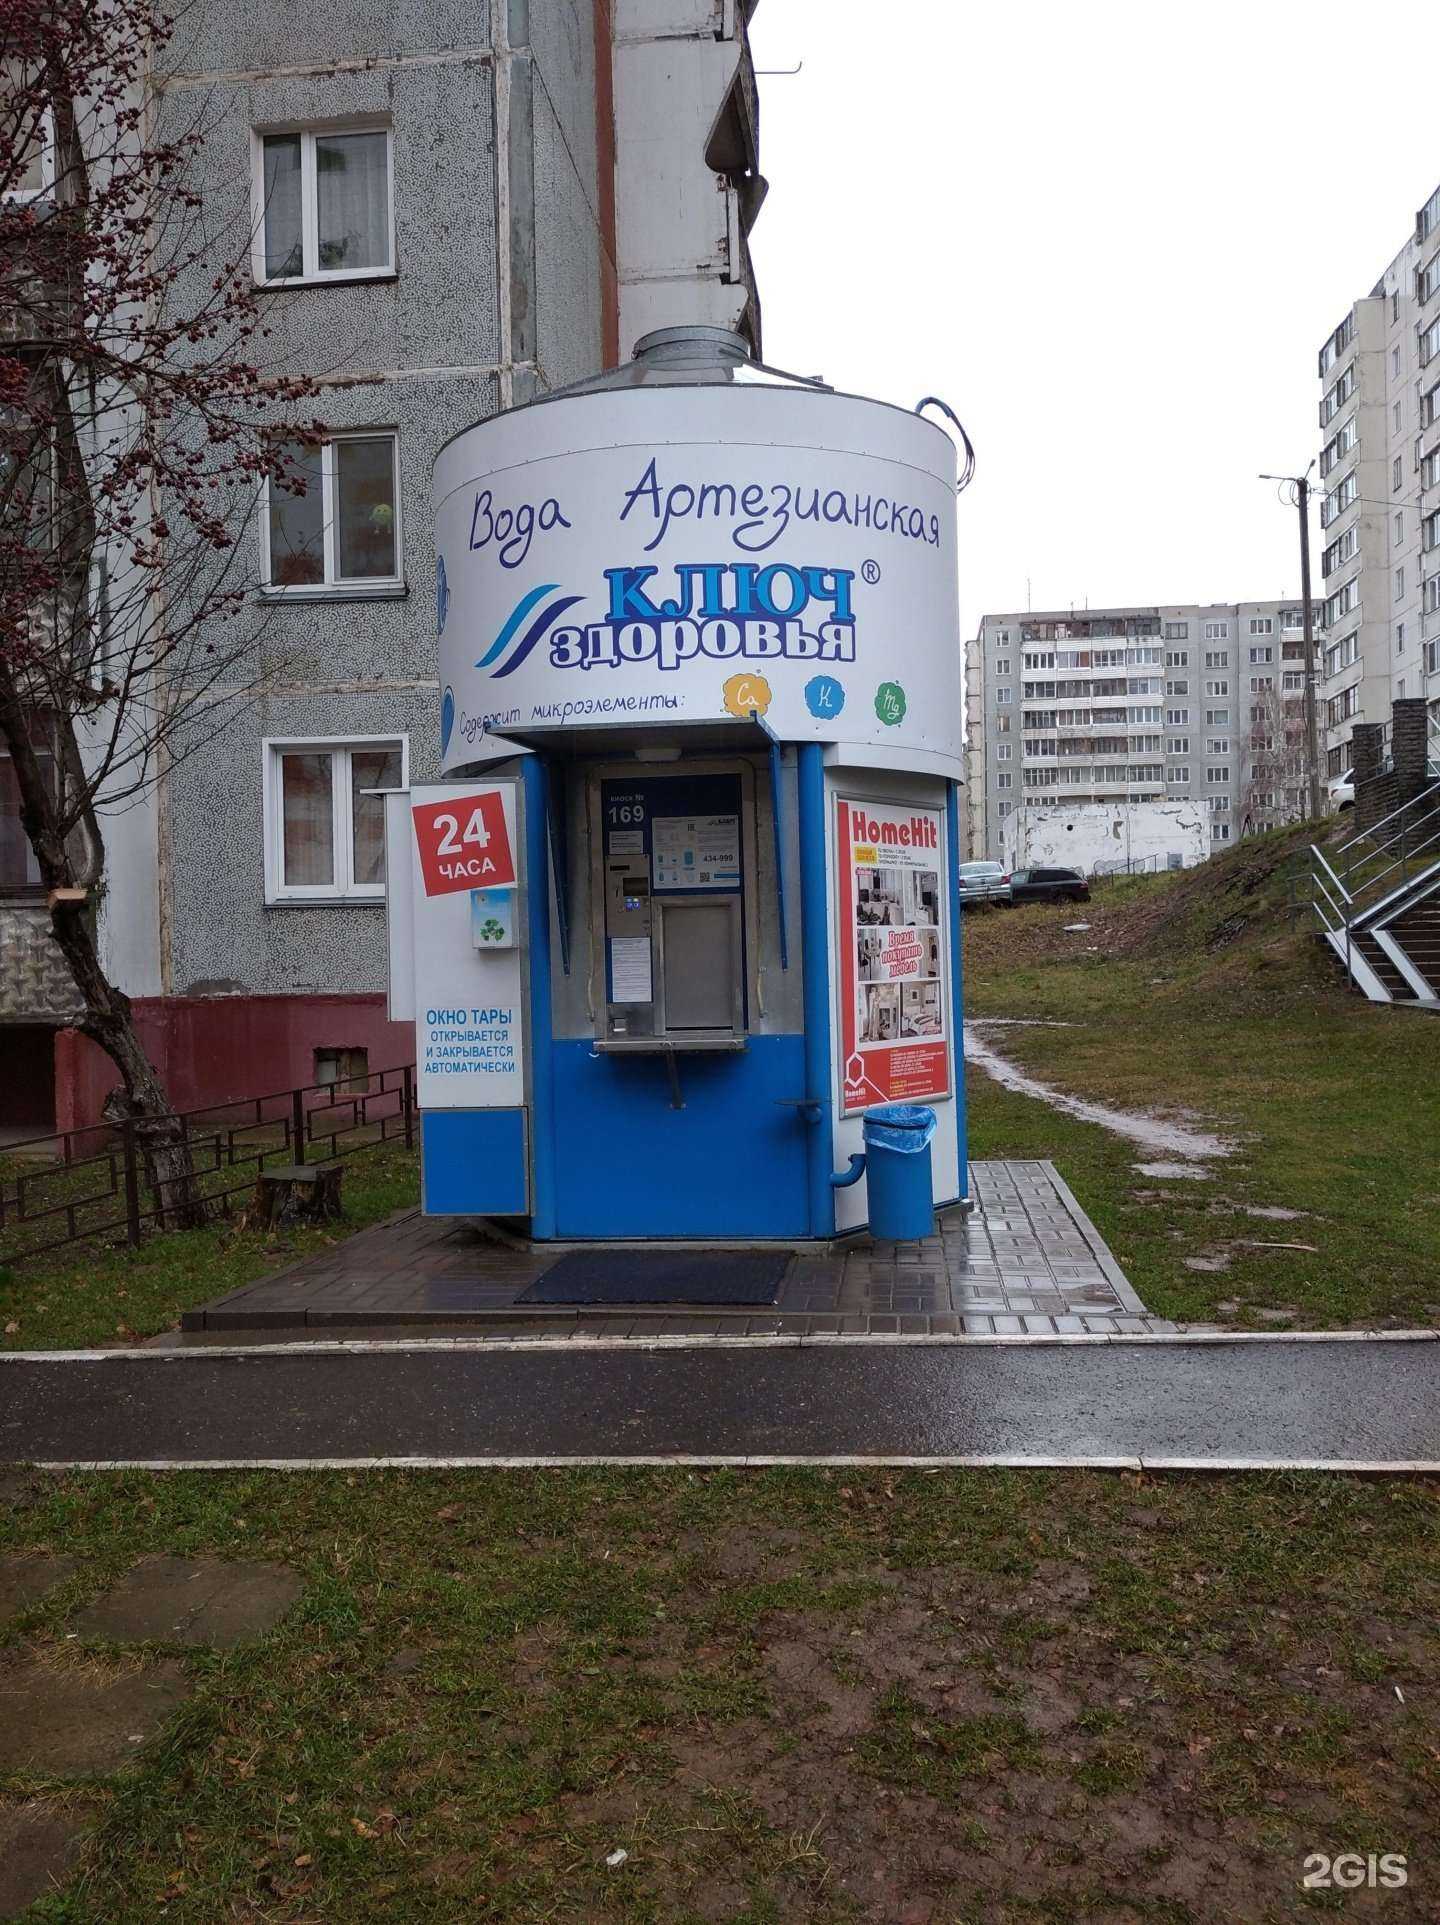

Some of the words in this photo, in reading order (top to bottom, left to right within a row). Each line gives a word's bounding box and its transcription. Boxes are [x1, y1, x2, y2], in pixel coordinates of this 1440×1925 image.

[469, 490, 571, 568] Вода
[620, 457, 941, 551] Артезианская
[604, 563, 855, 621] КЛЮЧ
[531, 694, 686, 724] микроэлементы:
[737, 683, 759, 706] Ca
[818, 685, 833, 707] K
[884, 689, 900, 719] Mg
[608, 805, 645, 824] 169
[433, 808, 491, 856] 24
[852, 811, 937, 848] HomeHit
[438, 857, 496, 880] ЧАСА
[888, 931, 915, 947] Время
[426, 1009, 467, 1025] ОКНО
[471, 1009, 512, 1024] ТАРЫ
[430, 1030, 509, 1042] ОТКРЫВАЕТСЯ
[426, 1046, 433, 1058] И
[436, 1045, 513, 1058] ЗАКРЫВАЕТСЯ
[424, 1061, 515, 1074] АВТОМАТИЧЕСКИ
